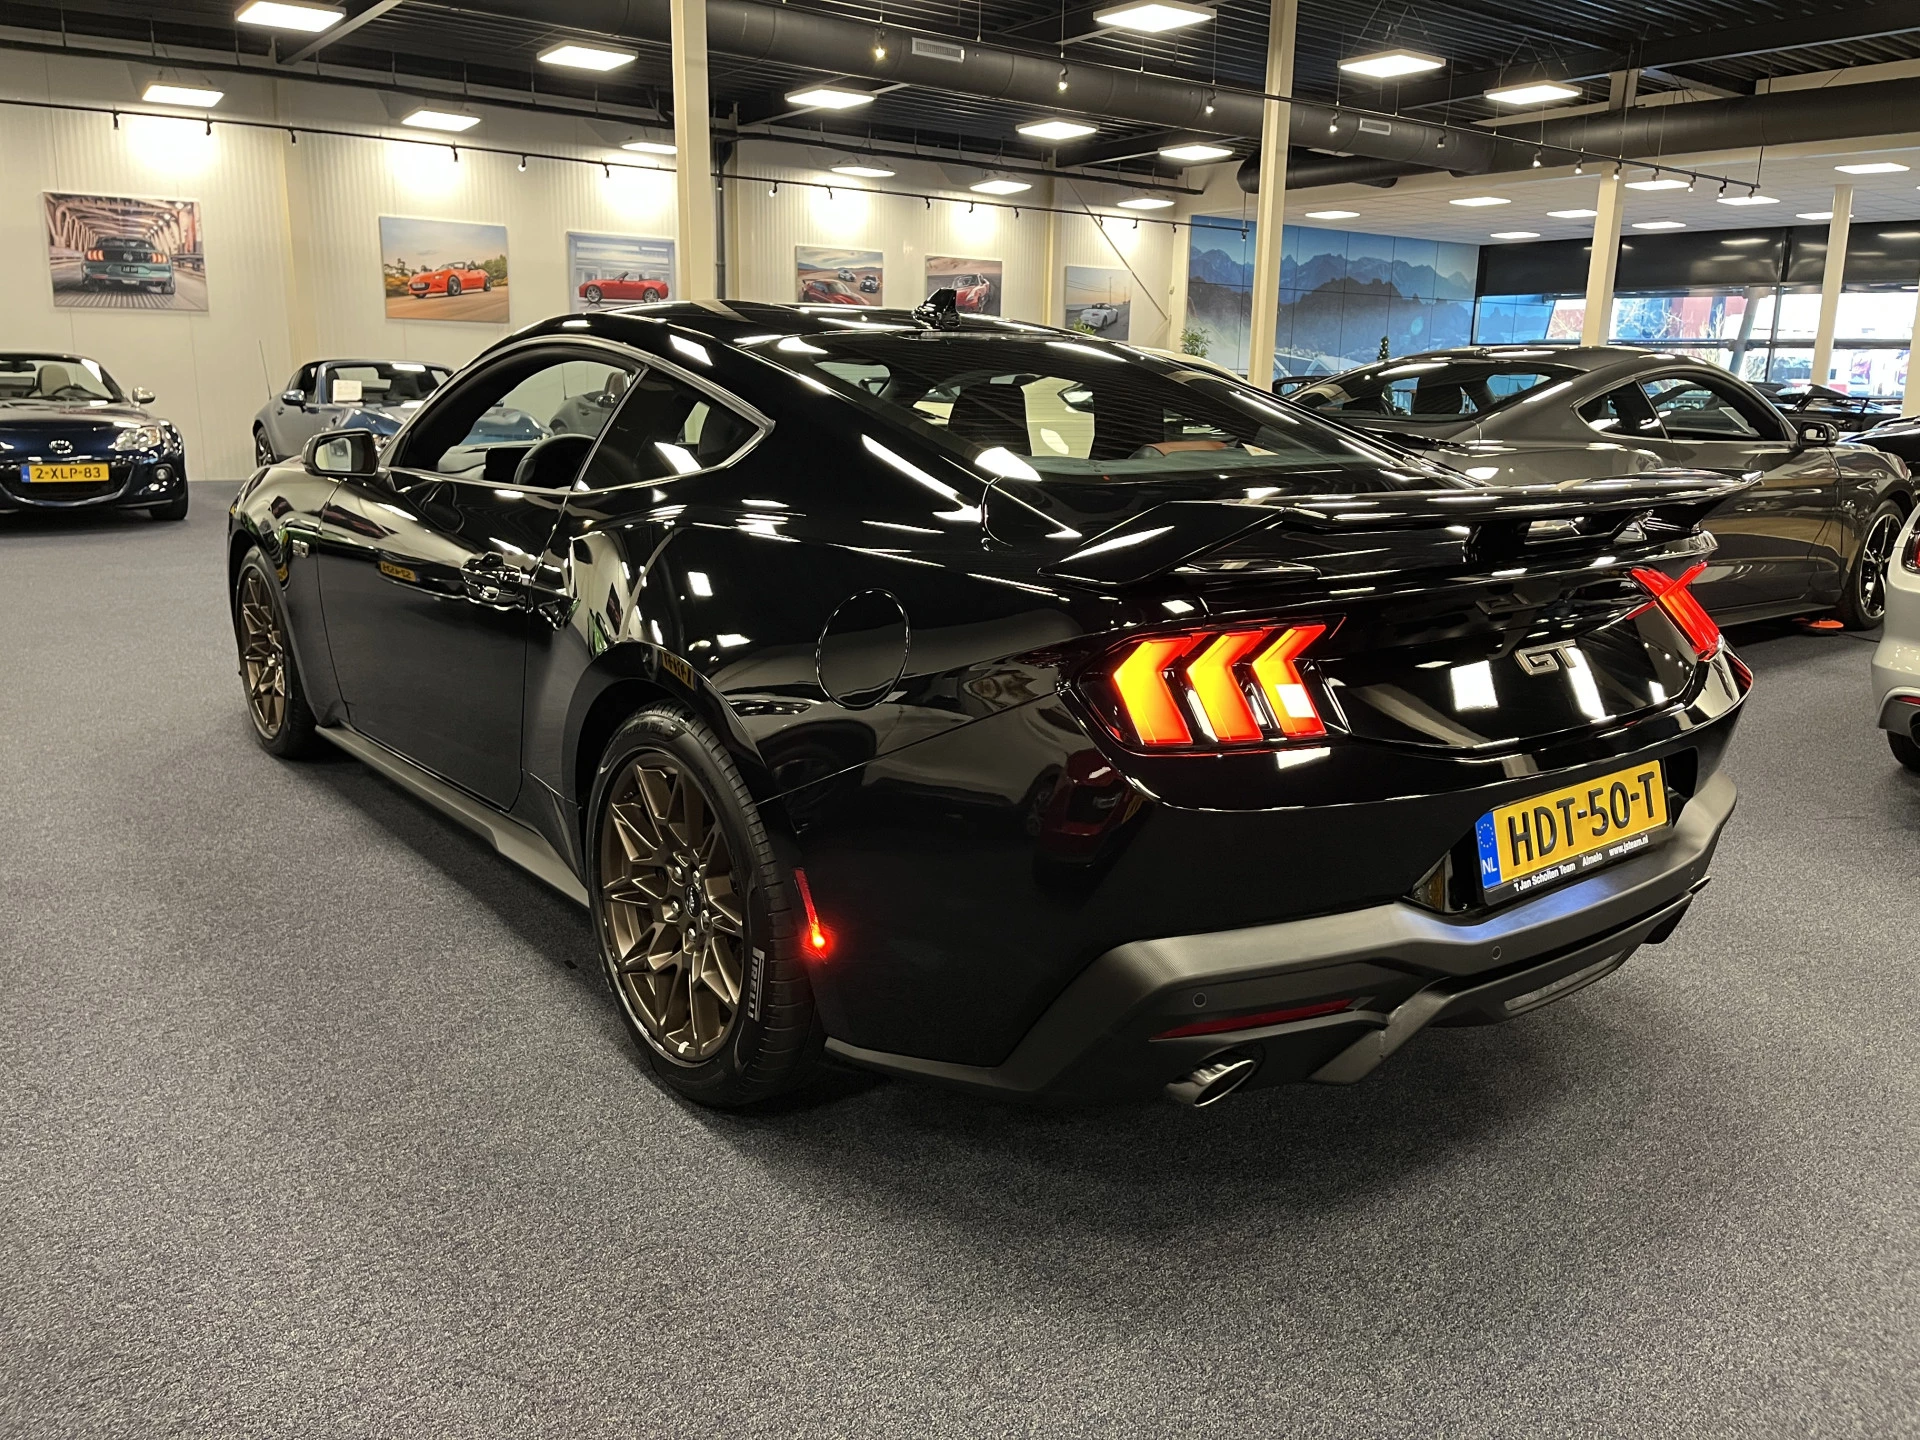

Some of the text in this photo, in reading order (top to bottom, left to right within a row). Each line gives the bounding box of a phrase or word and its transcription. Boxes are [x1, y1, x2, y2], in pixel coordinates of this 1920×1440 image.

[35, 467, 101, 480] 2-XLP-83
[1515, 639, 1576, 676] GT
[1507, 771, 1655, 867] HDT-50-T
[1481, 859, 1498, 875] NL
[1520, 877, 1532, 891] Jan
[1532, 866, 1559, 886] Scholten
[1559, 861, 1576, 876] Team
[1582, 851, 1603, 867] Almelo
[1608, 834, 1649, 857] www.jsteam.nl
[747, 946, 766, 1022] PIRELLI
